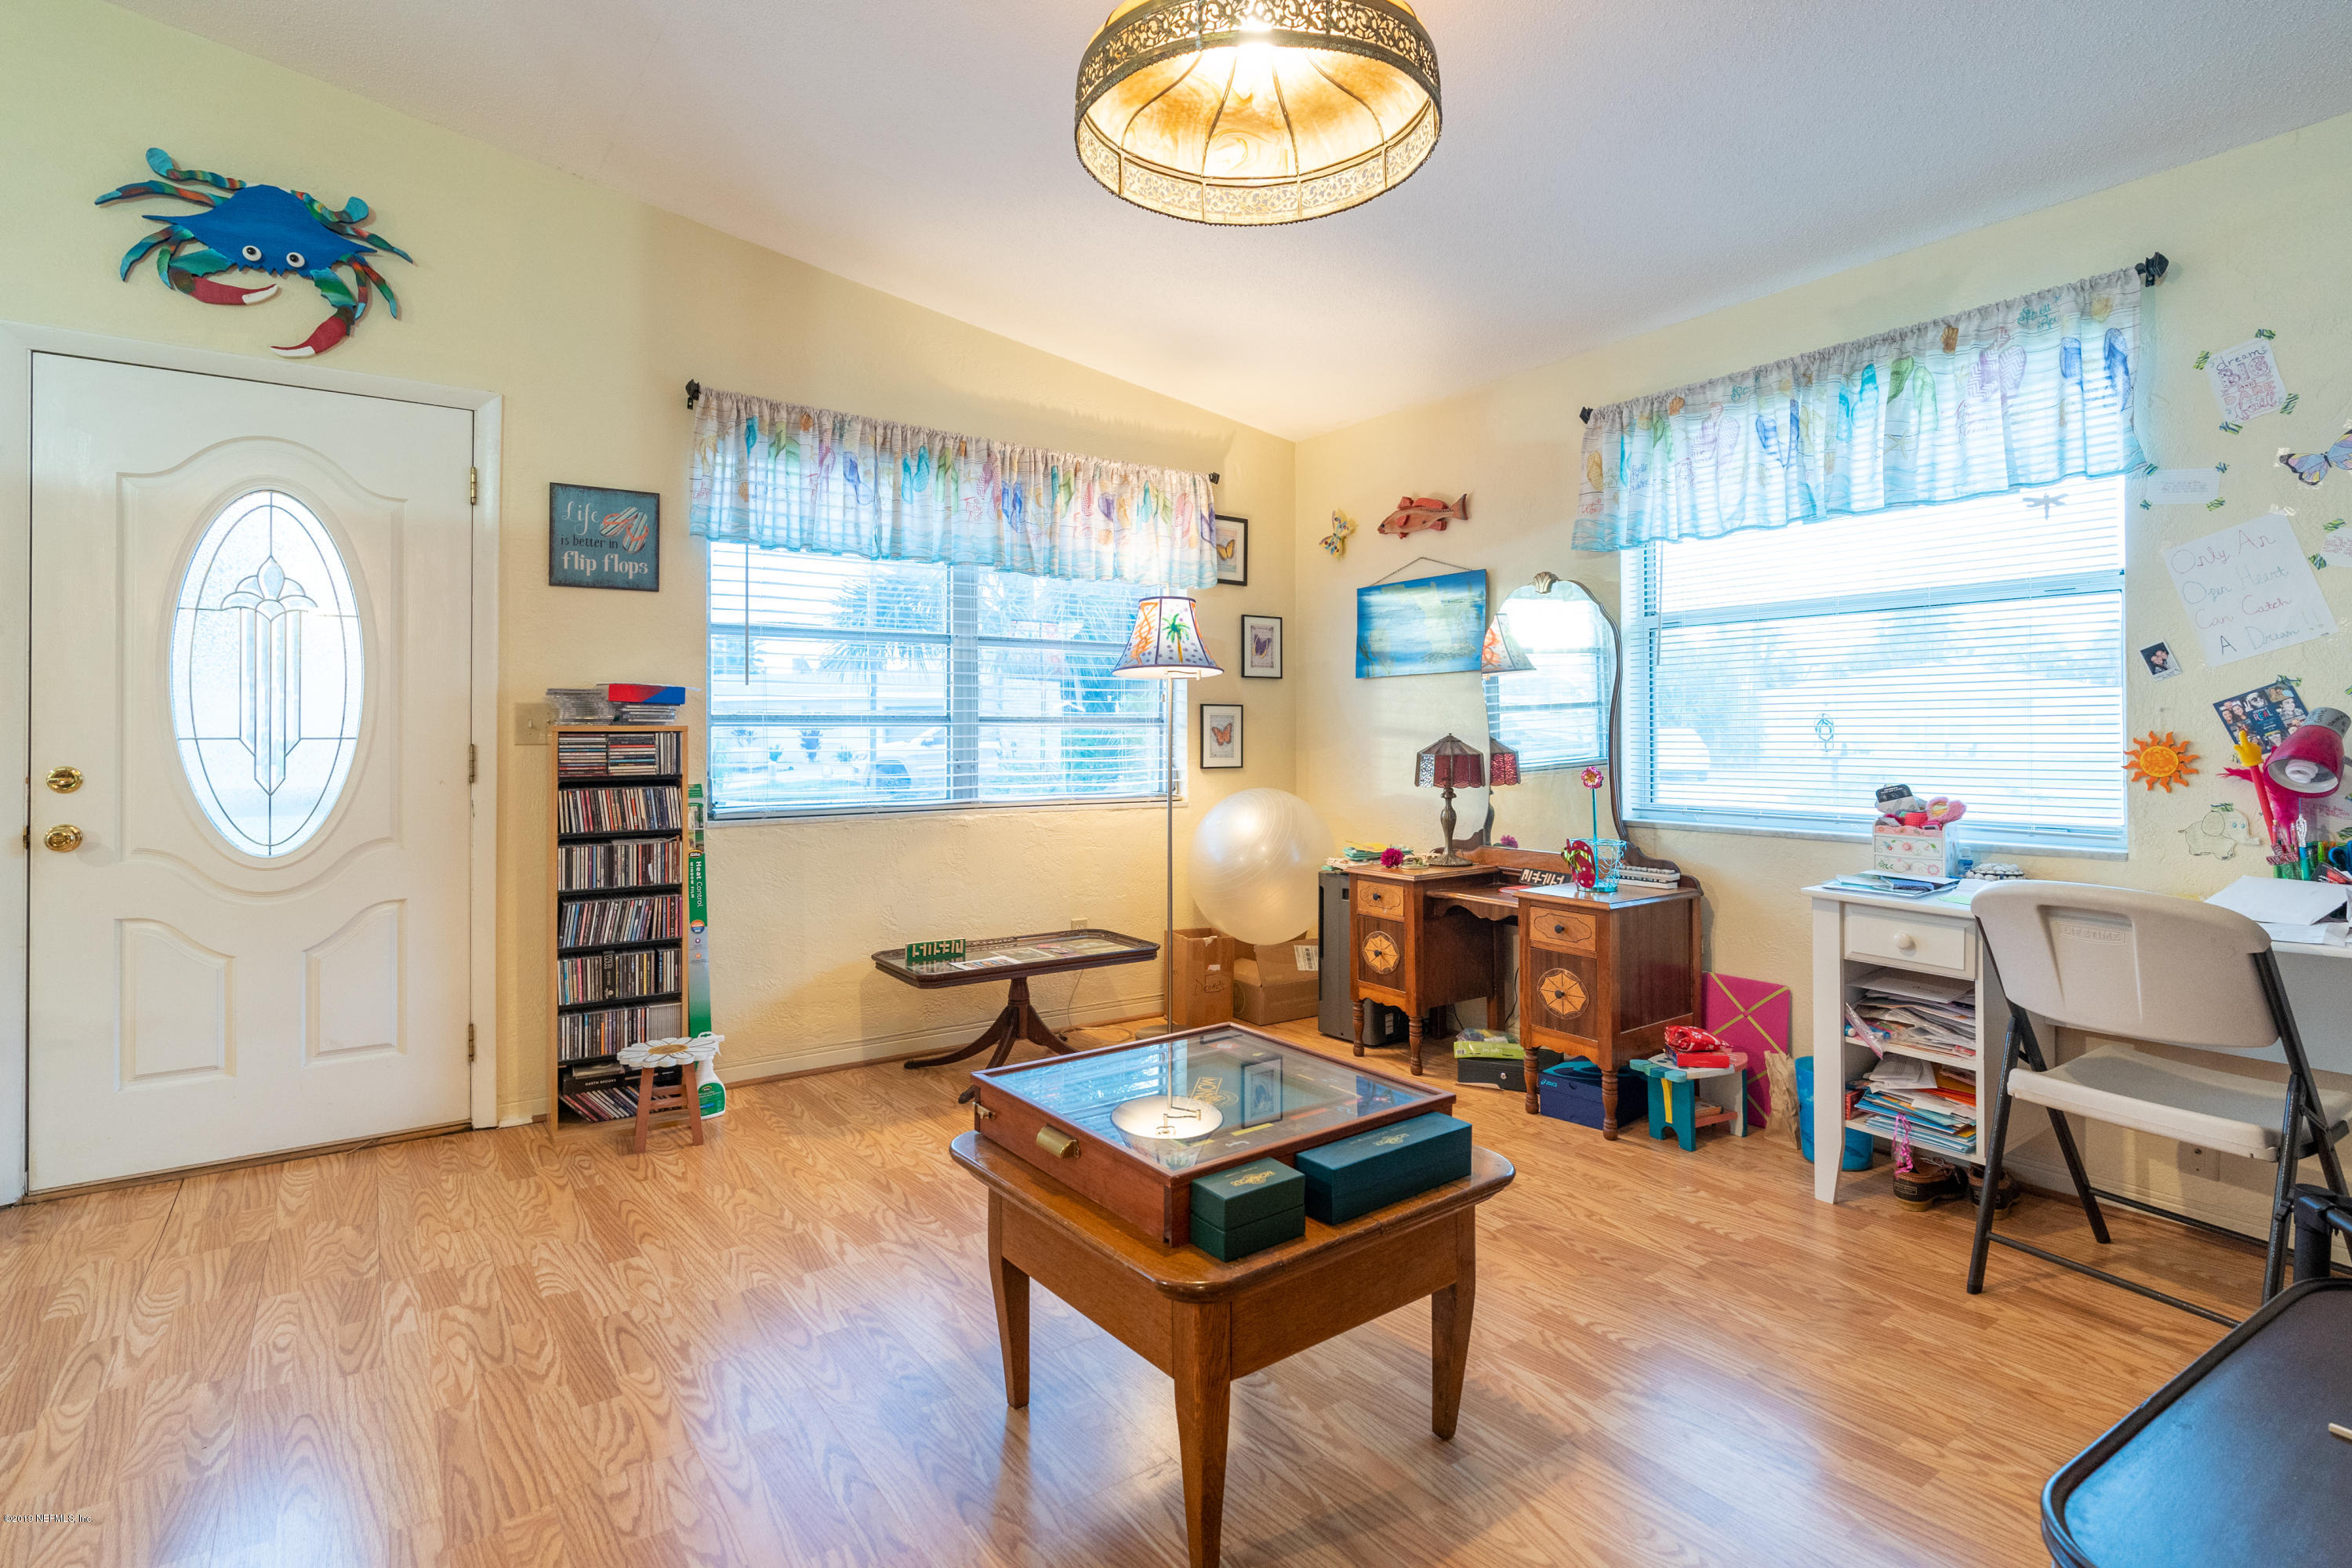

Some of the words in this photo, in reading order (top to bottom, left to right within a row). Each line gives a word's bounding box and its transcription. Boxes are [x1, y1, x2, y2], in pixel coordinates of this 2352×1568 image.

[2216, 350, 2268, 371] dream
[561, 502, 600, 535] Life
[561, 535, 569, 546] is
[573, 535, 606, 548] better
[609, 539, 619, 550] in
[2171, 546, 2230, 574] Only
[2238, 530, 2276, 554] An
[561, 550, 597, 576] flip
[602, 554, 648, 579] flops
[2182, 581, 2232, 604] Open
[2235, 564, 2289, 590] Heart
[2195, 608, 2234, 629] Can
[2241, 594, 2292, 615] Catch
[2220, 635, 2238, 655] A
[2252, 709, 2274, 721] REAL
